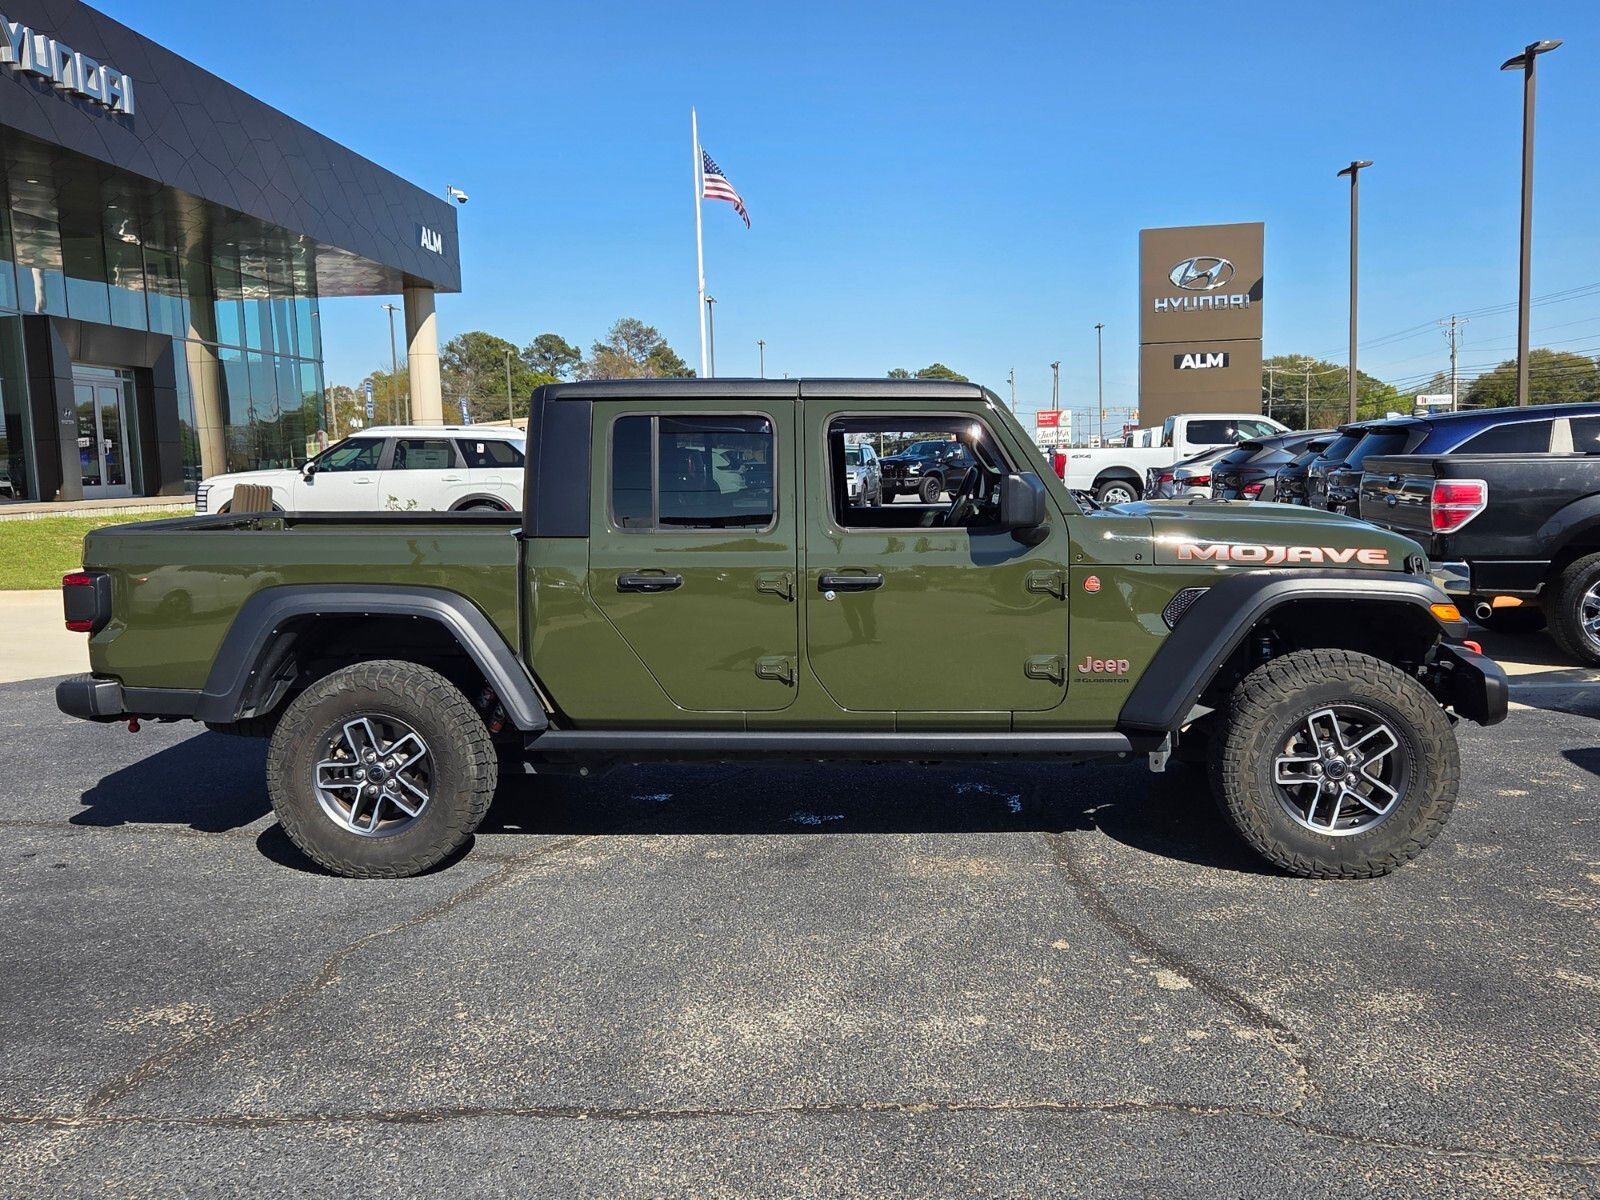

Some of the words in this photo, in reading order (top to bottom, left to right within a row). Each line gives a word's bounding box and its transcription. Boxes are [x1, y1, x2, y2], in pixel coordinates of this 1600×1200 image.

[0, 14, 134, 115] YUNDAI
[421, 226, 442, 255] ALM
[1154, 294, 1249, 312] HYUNDAI
[1180, 353, 1224, 369] ALM
[1177, 544, 1389, 565] MOJAVE
[1078, 656, 1130, 674] Jeep
